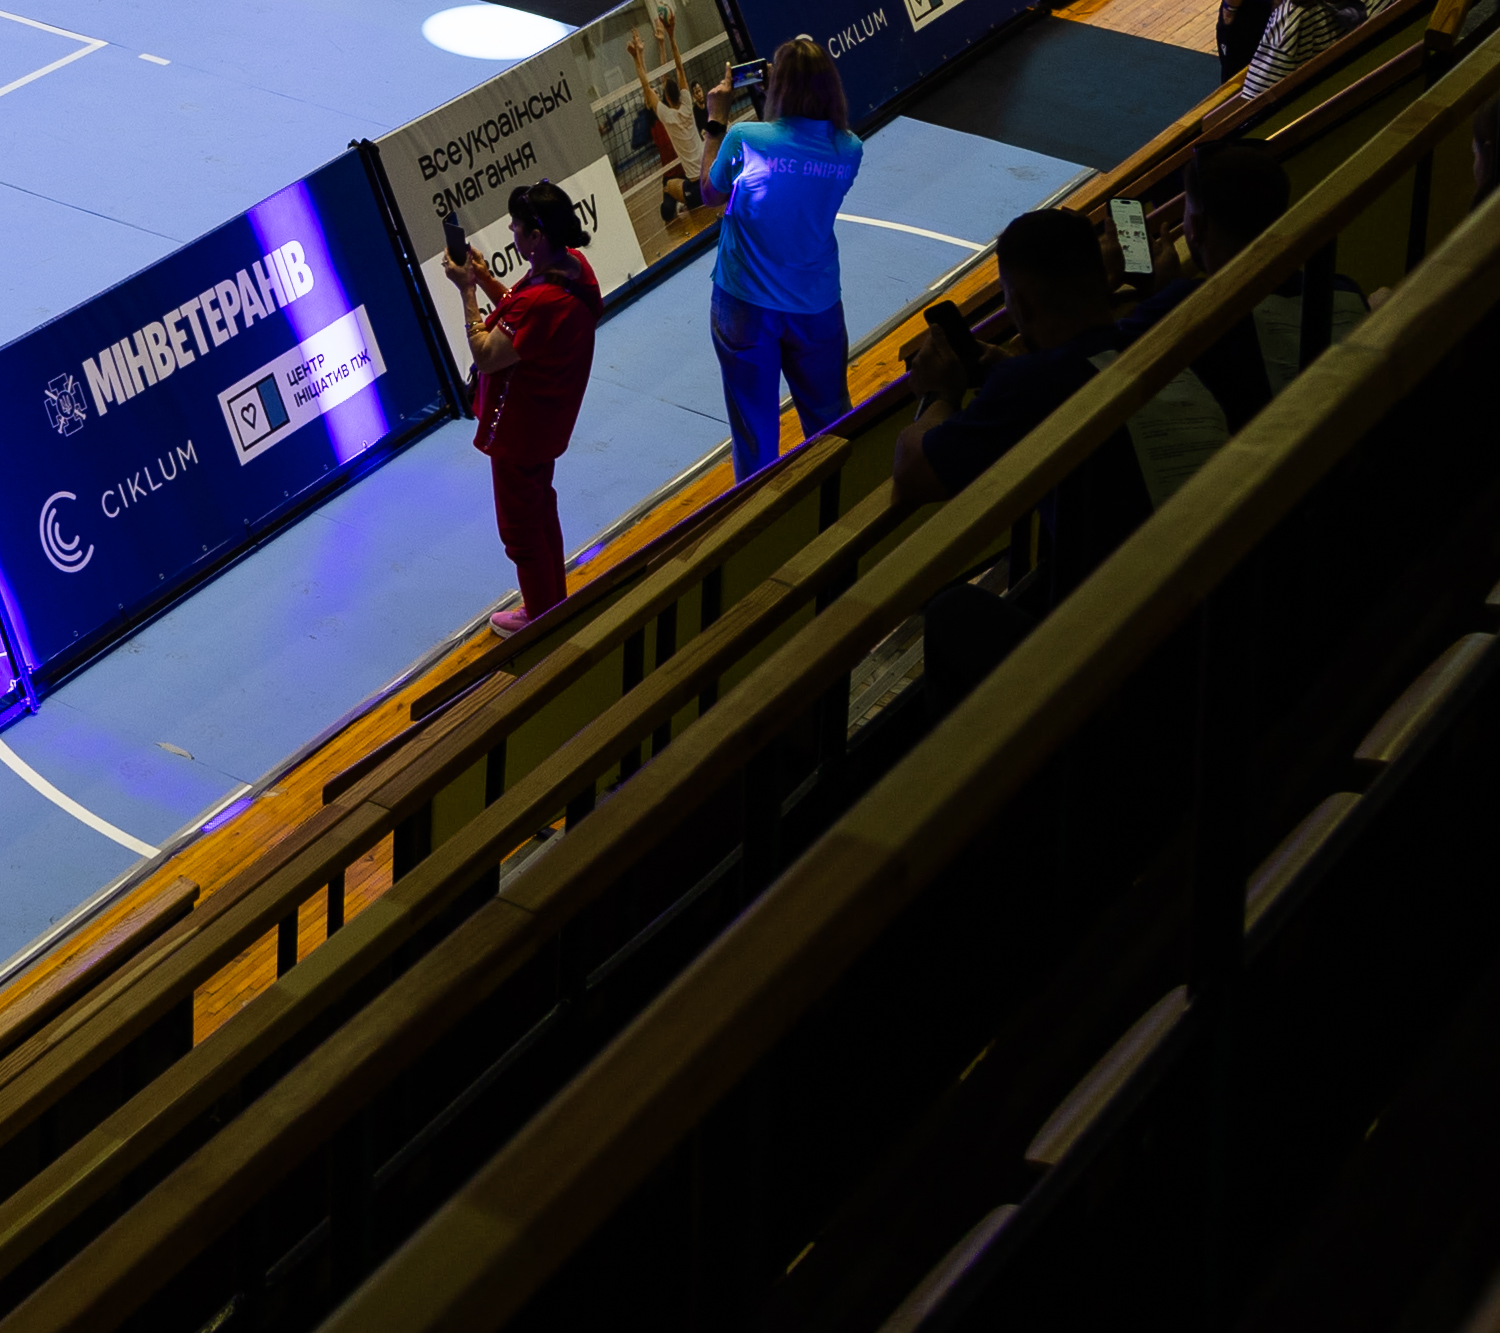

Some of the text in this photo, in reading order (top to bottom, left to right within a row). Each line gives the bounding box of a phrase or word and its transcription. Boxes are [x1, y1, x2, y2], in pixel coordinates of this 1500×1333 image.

[828, 8, 888, 61] CIKLUM
[418, 71, 573, 181] всеукраїнські
[432, 140, 537, 219] змагання
[81, 239, 315, 417] МІНВЕТЕРАНІВ
[287, 351, 327, 386] ЦЕНТР
[293, 347, 372, 407] ІНІЦІАТИВ ПЖ
[101, 437, 200, 520] CIKLUM
